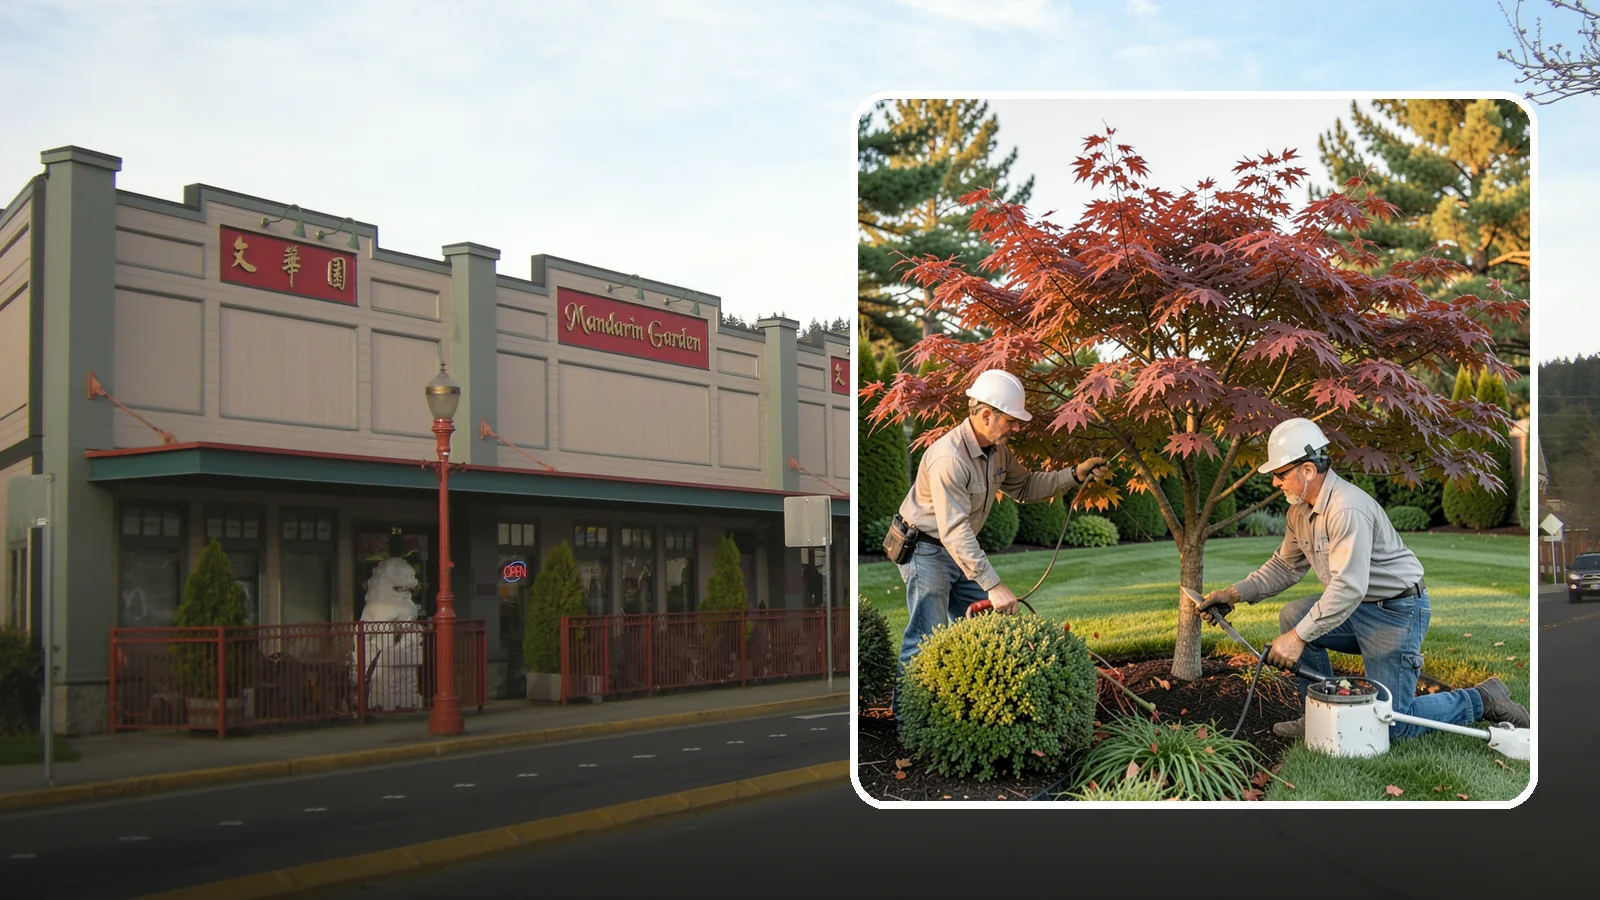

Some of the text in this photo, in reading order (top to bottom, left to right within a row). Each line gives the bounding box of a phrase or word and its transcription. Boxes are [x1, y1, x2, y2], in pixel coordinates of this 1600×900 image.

[564, 302, 701, 352] Mandarin Garden
[834, 363, 846, 386] 文
[503, 565, 527, 578] OPEN
